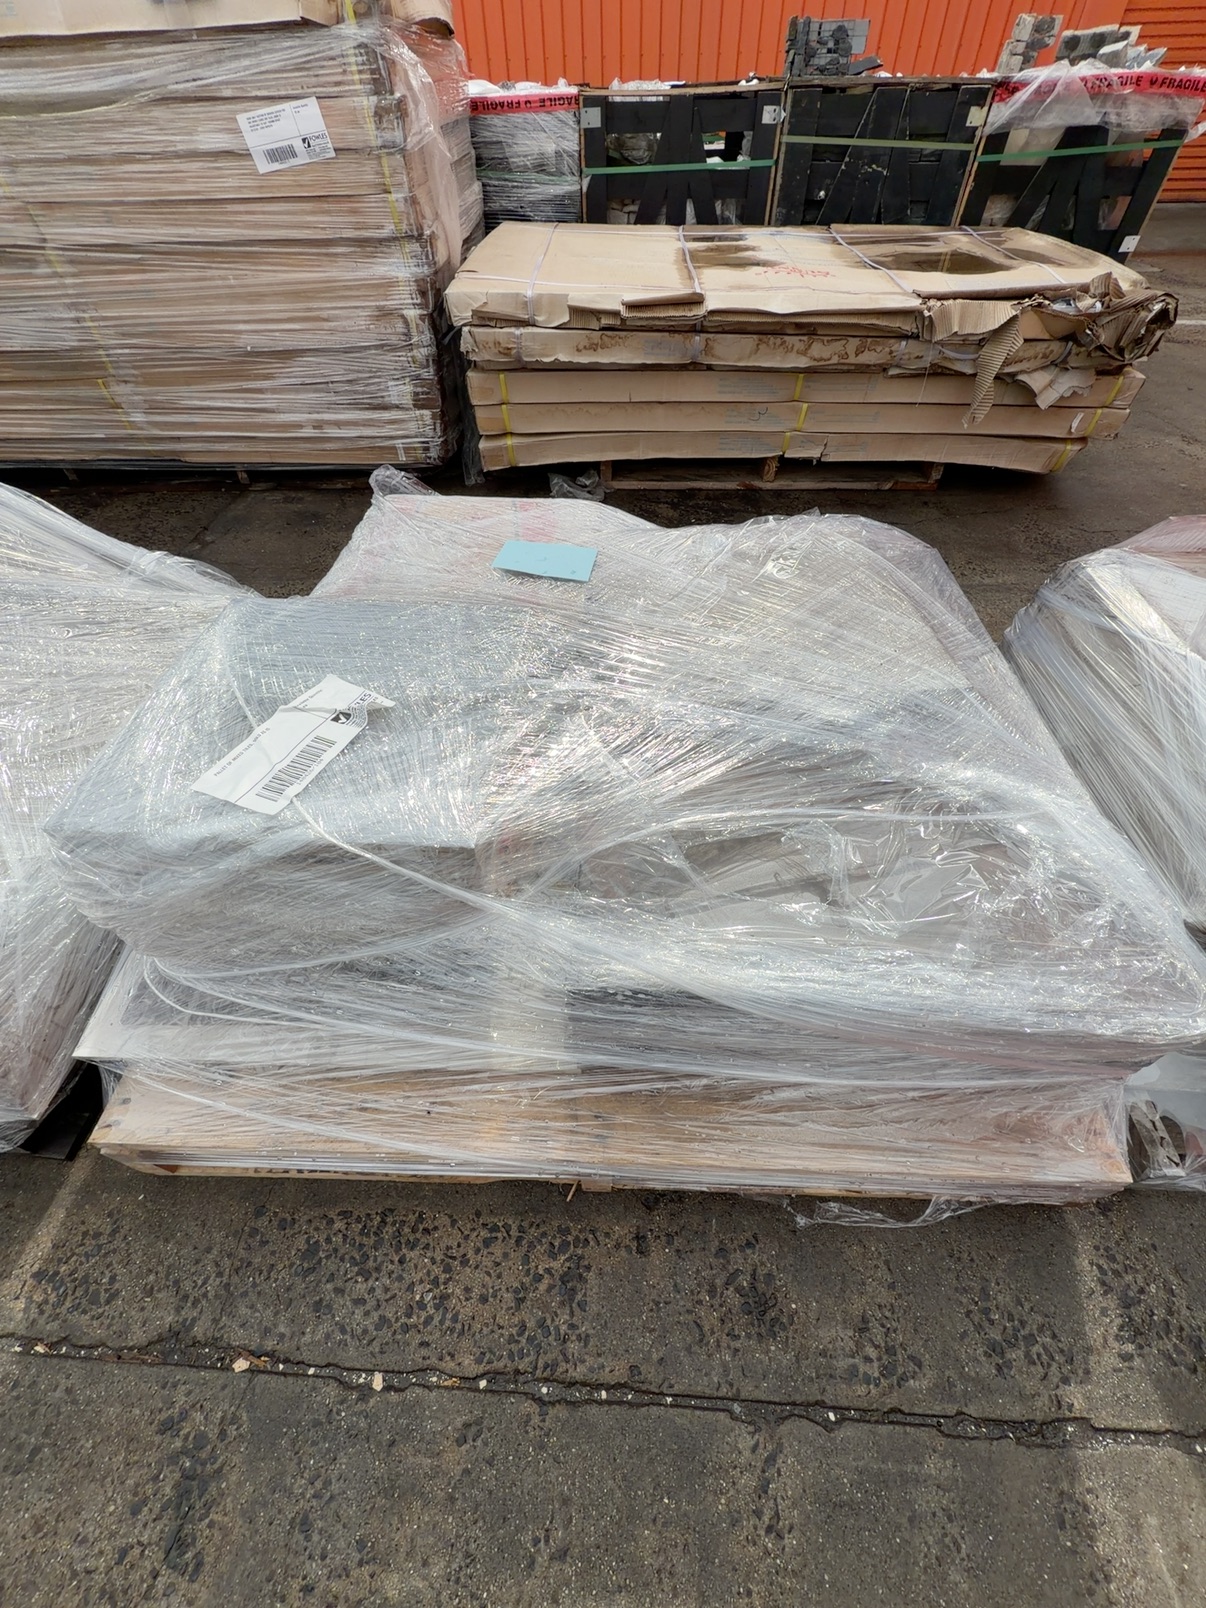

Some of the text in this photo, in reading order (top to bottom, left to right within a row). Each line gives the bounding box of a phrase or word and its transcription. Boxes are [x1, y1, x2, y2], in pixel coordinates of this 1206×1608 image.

[1091, 75, 1143, 90] FRAGILE
[470, 94, 580, 111] RAGILE FRAGILE
[308, 132, 328, 141] FOWLES
